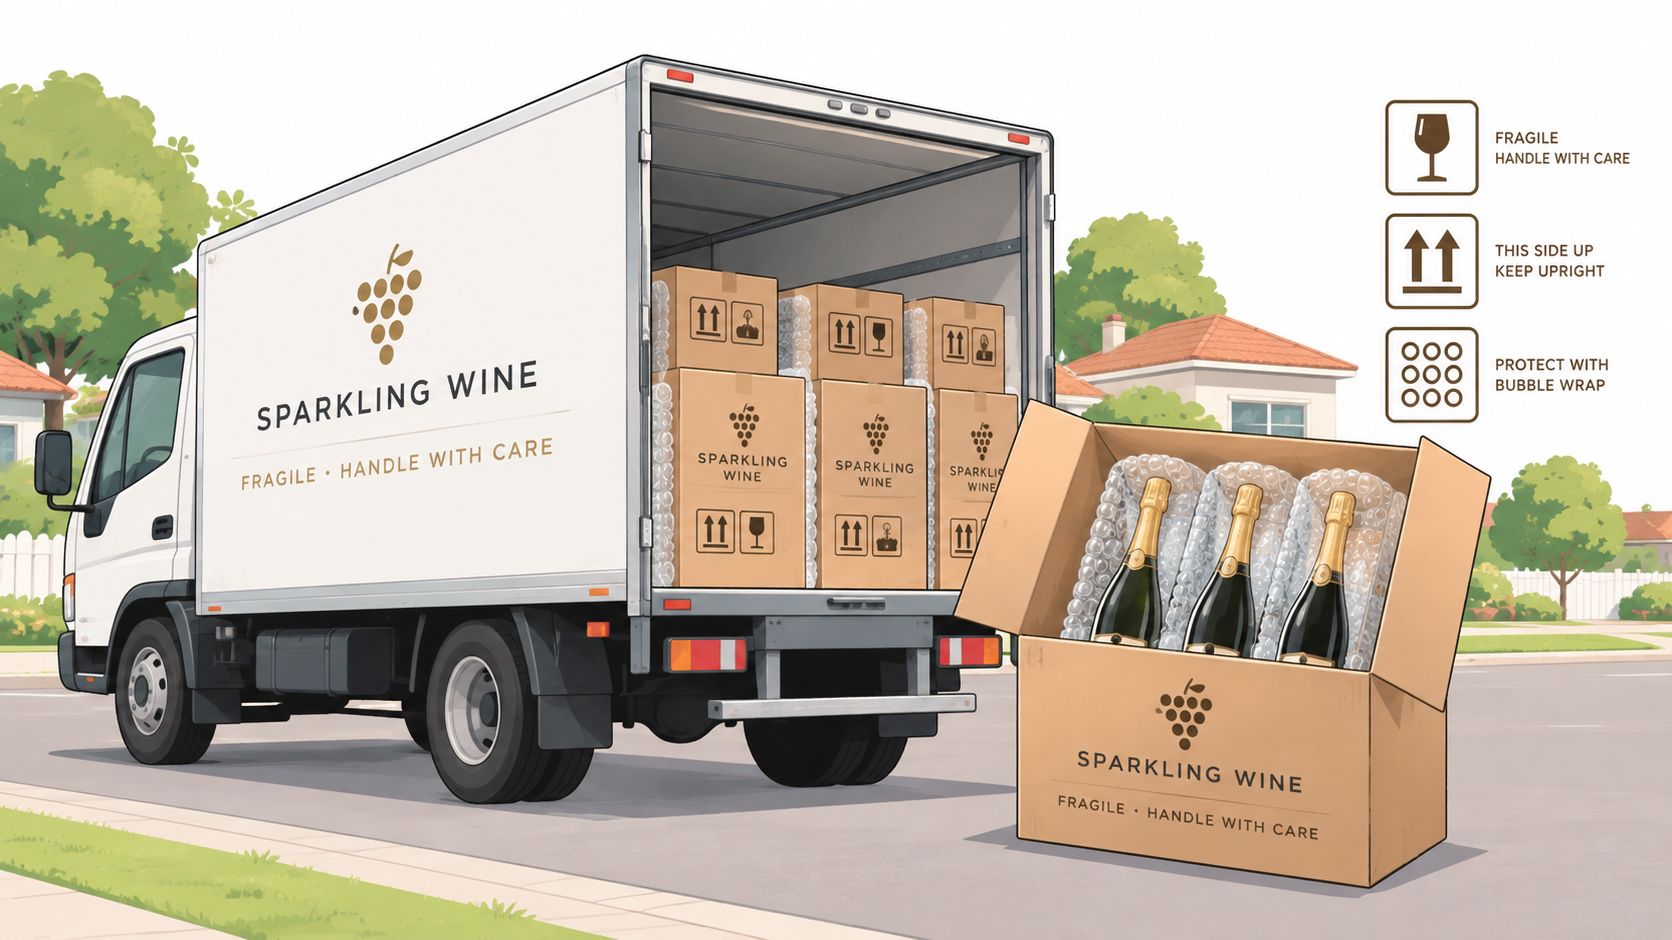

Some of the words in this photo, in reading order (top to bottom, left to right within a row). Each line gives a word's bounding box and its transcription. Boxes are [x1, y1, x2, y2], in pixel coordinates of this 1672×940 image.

[258, 380, 429, 431] SPARKLING
[447, 360, 536, 399] WINE
[242, 467, 315, 490] FRAGILE
[341, 454, 419, 479] HANDLE
[429, 447, 481, 468] WITH
[493, 438, 552, 460] CARE
[698, 453, 787, 467] SPARKLING
[836, 460, 913, 473] SPARKLING
[723, 471, 761, 482] WINE
[859, 477, 891, 487] WINE
[968, 482, 996, 493] WINE
[1078, 751, 1220, 783] SPARKLING
[1235, 770, 1301, 793] WINE
[1059, 796, 1124, 814] FRAGILE
[1148, 808, 1213, 826] HANDLE
[1222, 817, 1264, 833] WITH
[1273, 824, 1318, 840] CARE
